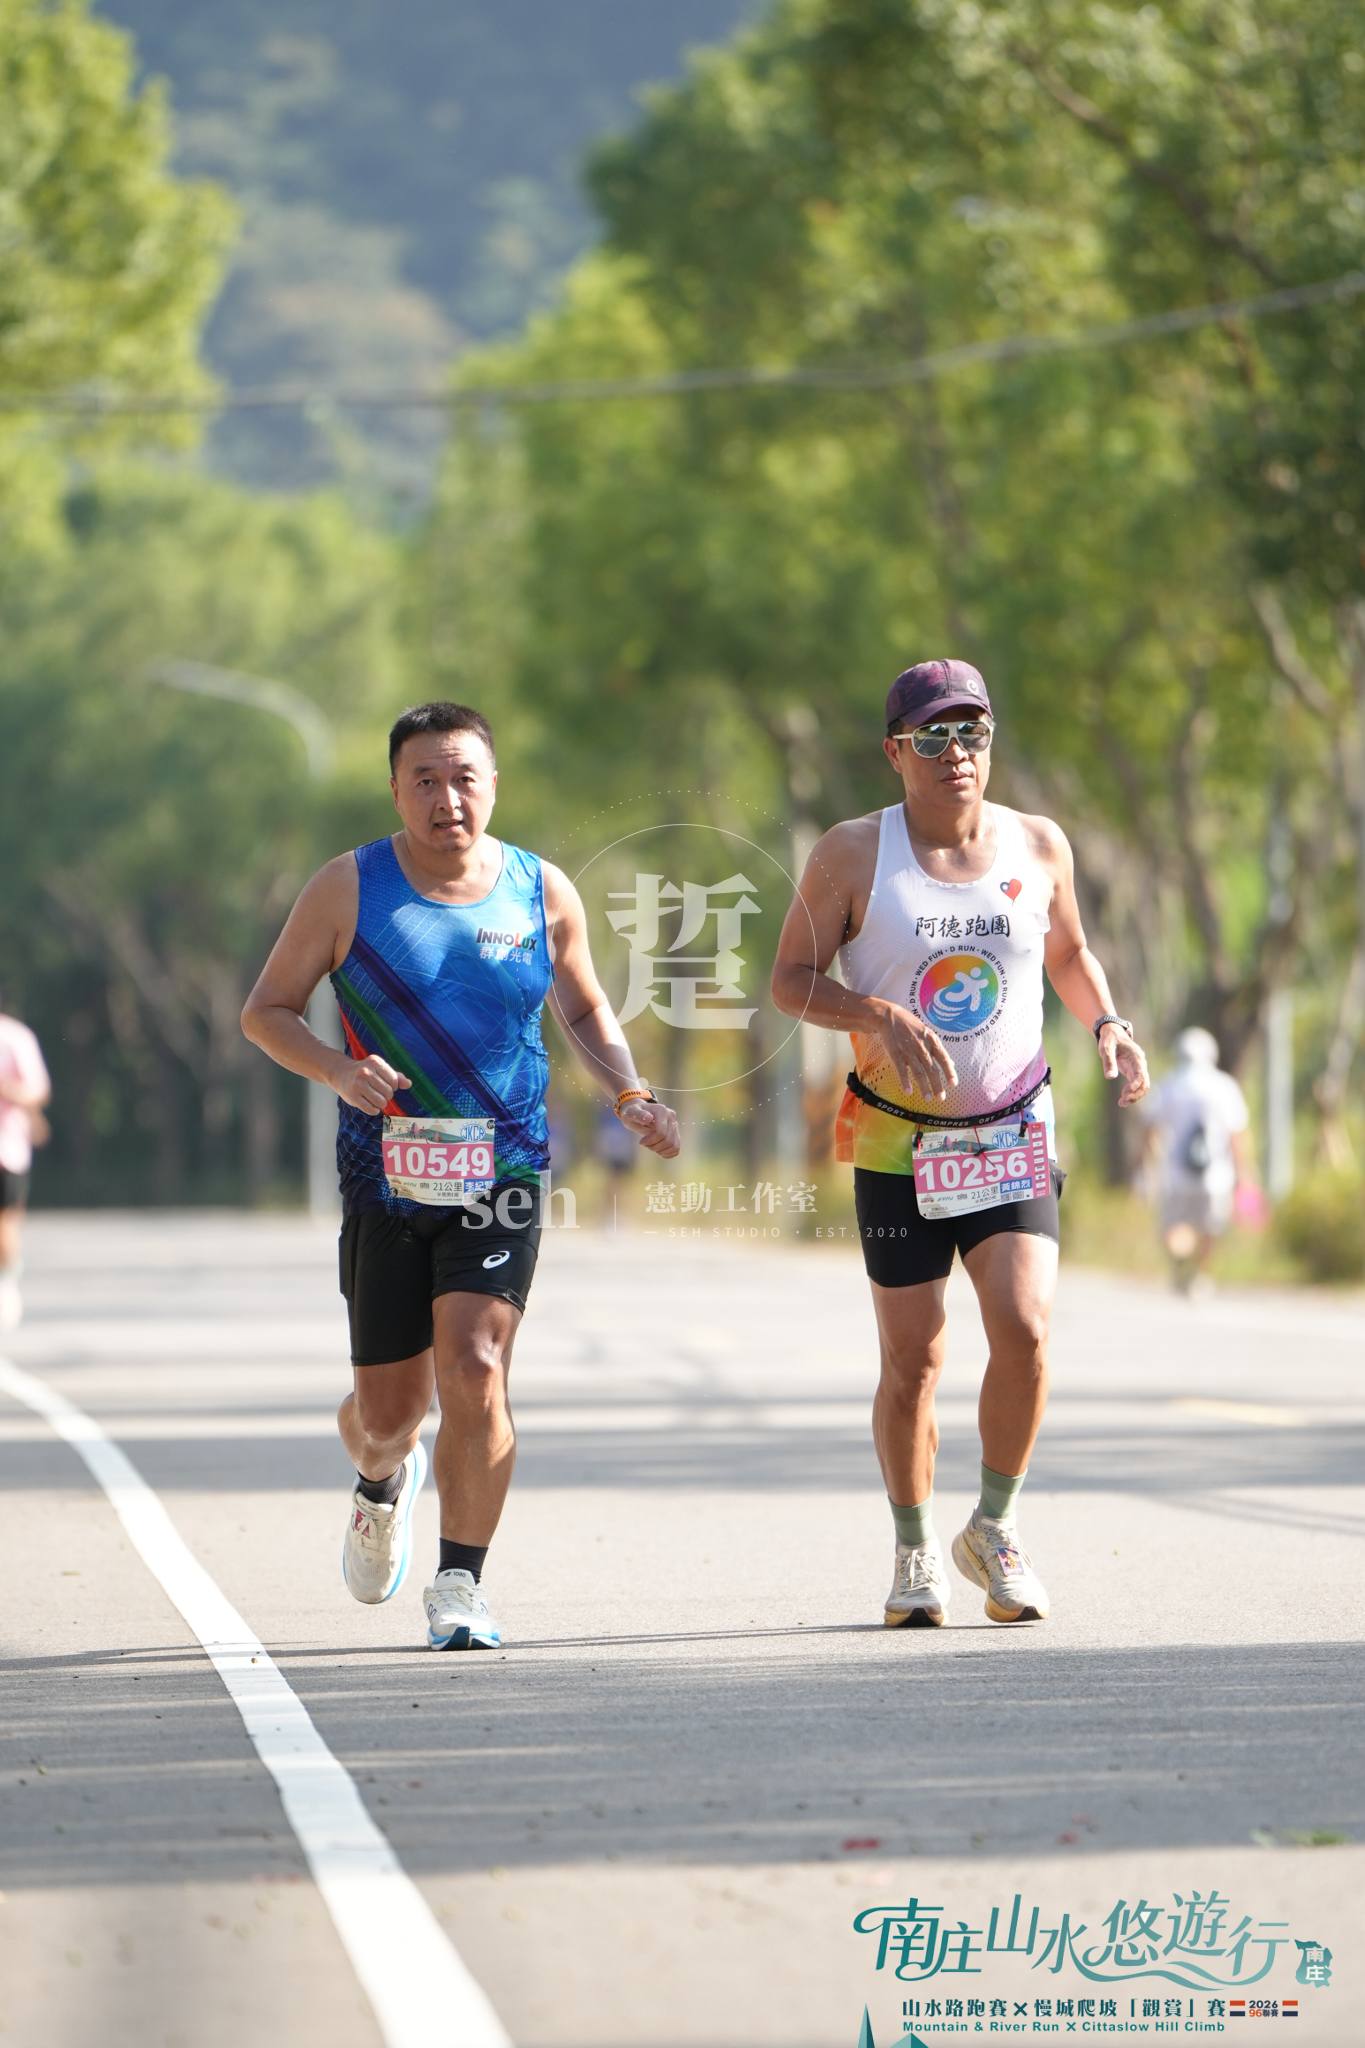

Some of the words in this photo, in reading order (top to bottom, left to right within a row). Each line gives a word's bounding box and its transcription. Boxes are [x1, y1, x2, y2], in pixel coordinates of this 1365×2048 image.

[915, 914, 1010, 938] 阿德跑團
[928, 949, 944, 962] FUN
[981, 948, 997, 962] WED
[915, 961, 929, 976] WED
[994, 960, 1005, 976] FUN
[910, 981, 918, 996] RUN
[989, 1009, 1002, 1025] WED
[943, 1035, 960, 1043] RUN
[974, 1026, 990, 1038] FUN
[877, 1101, 905, 1117] SPORT
[387, 1144, 491, 1177] 10549
[918, 1151, 1028, 1191] 10256
[432, 1181, 463, 1192] 21公里
[971, 1185, 999, 1199] 21公里
